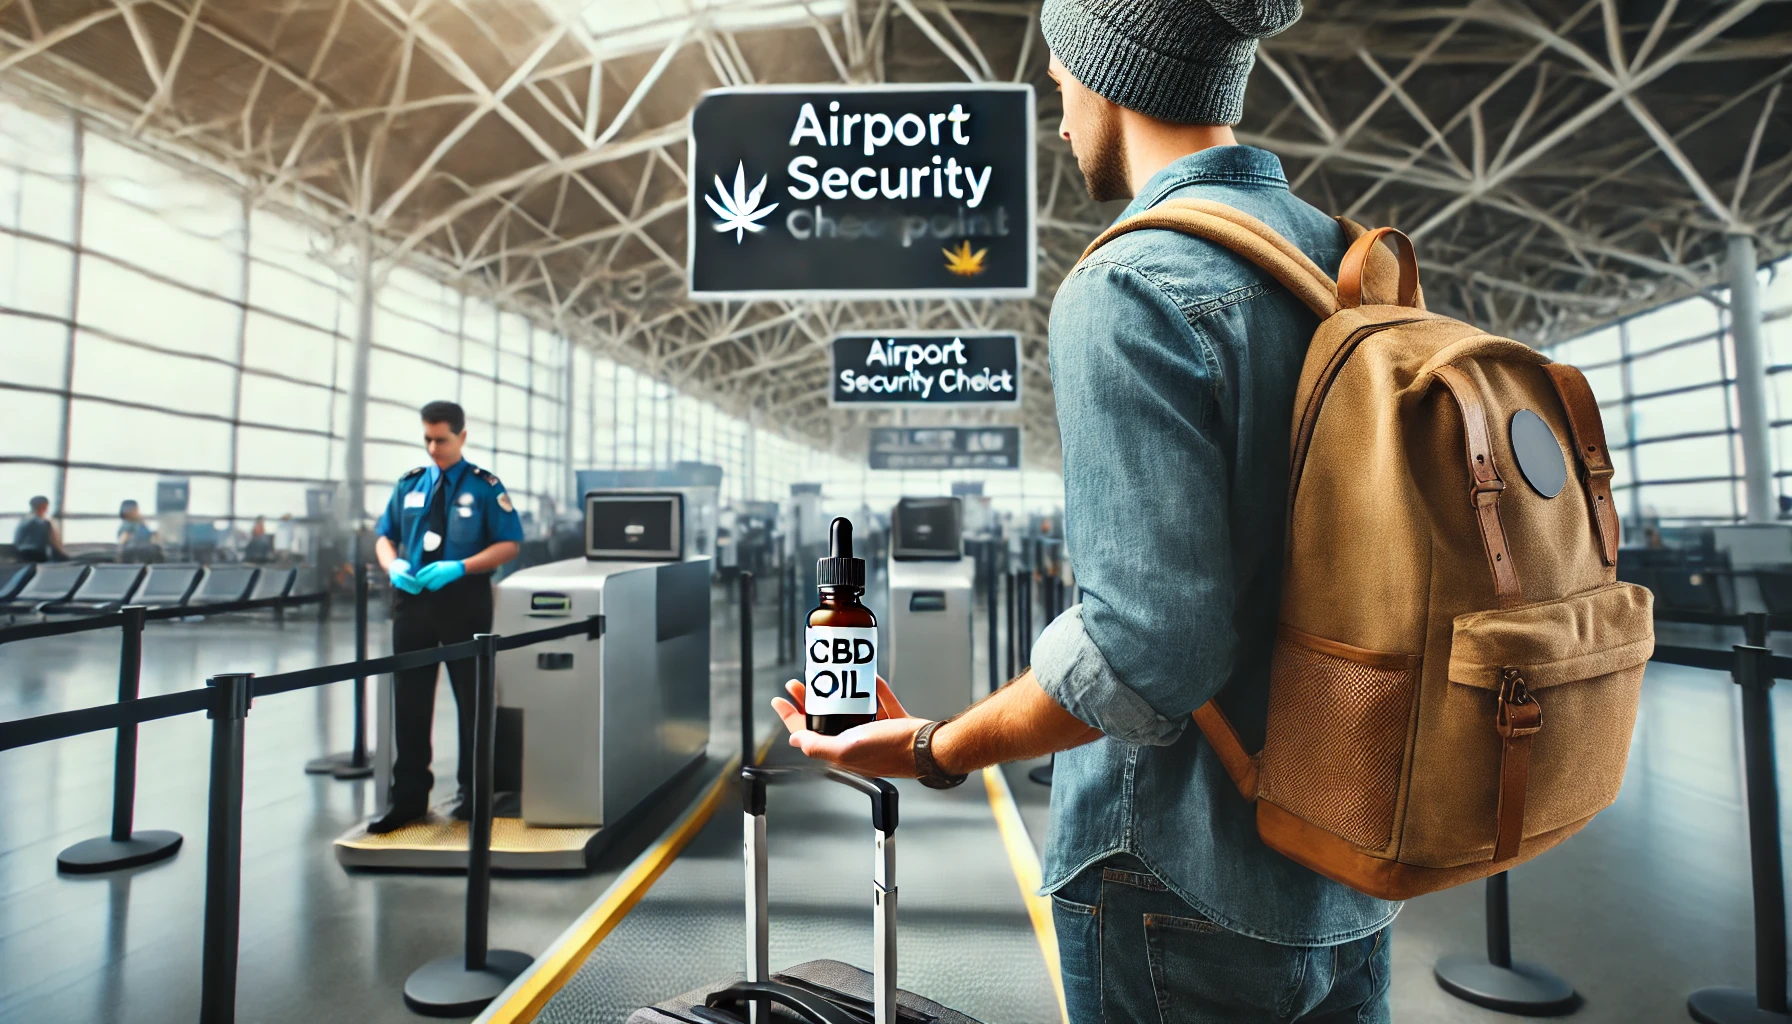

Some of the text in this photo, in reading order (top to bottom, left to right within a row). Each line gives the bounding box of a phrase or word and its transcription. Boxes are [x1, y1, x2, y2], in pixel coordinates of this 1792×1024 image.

[788, 101, 971, 156] Airport
[787, 154, 993, 208] Security
[865, 336, 968, 372] Airport
[840, 367, 934, 399] Security
[809, 637, 875, 665] CBD
[810, 669, 871, 699] OIL
